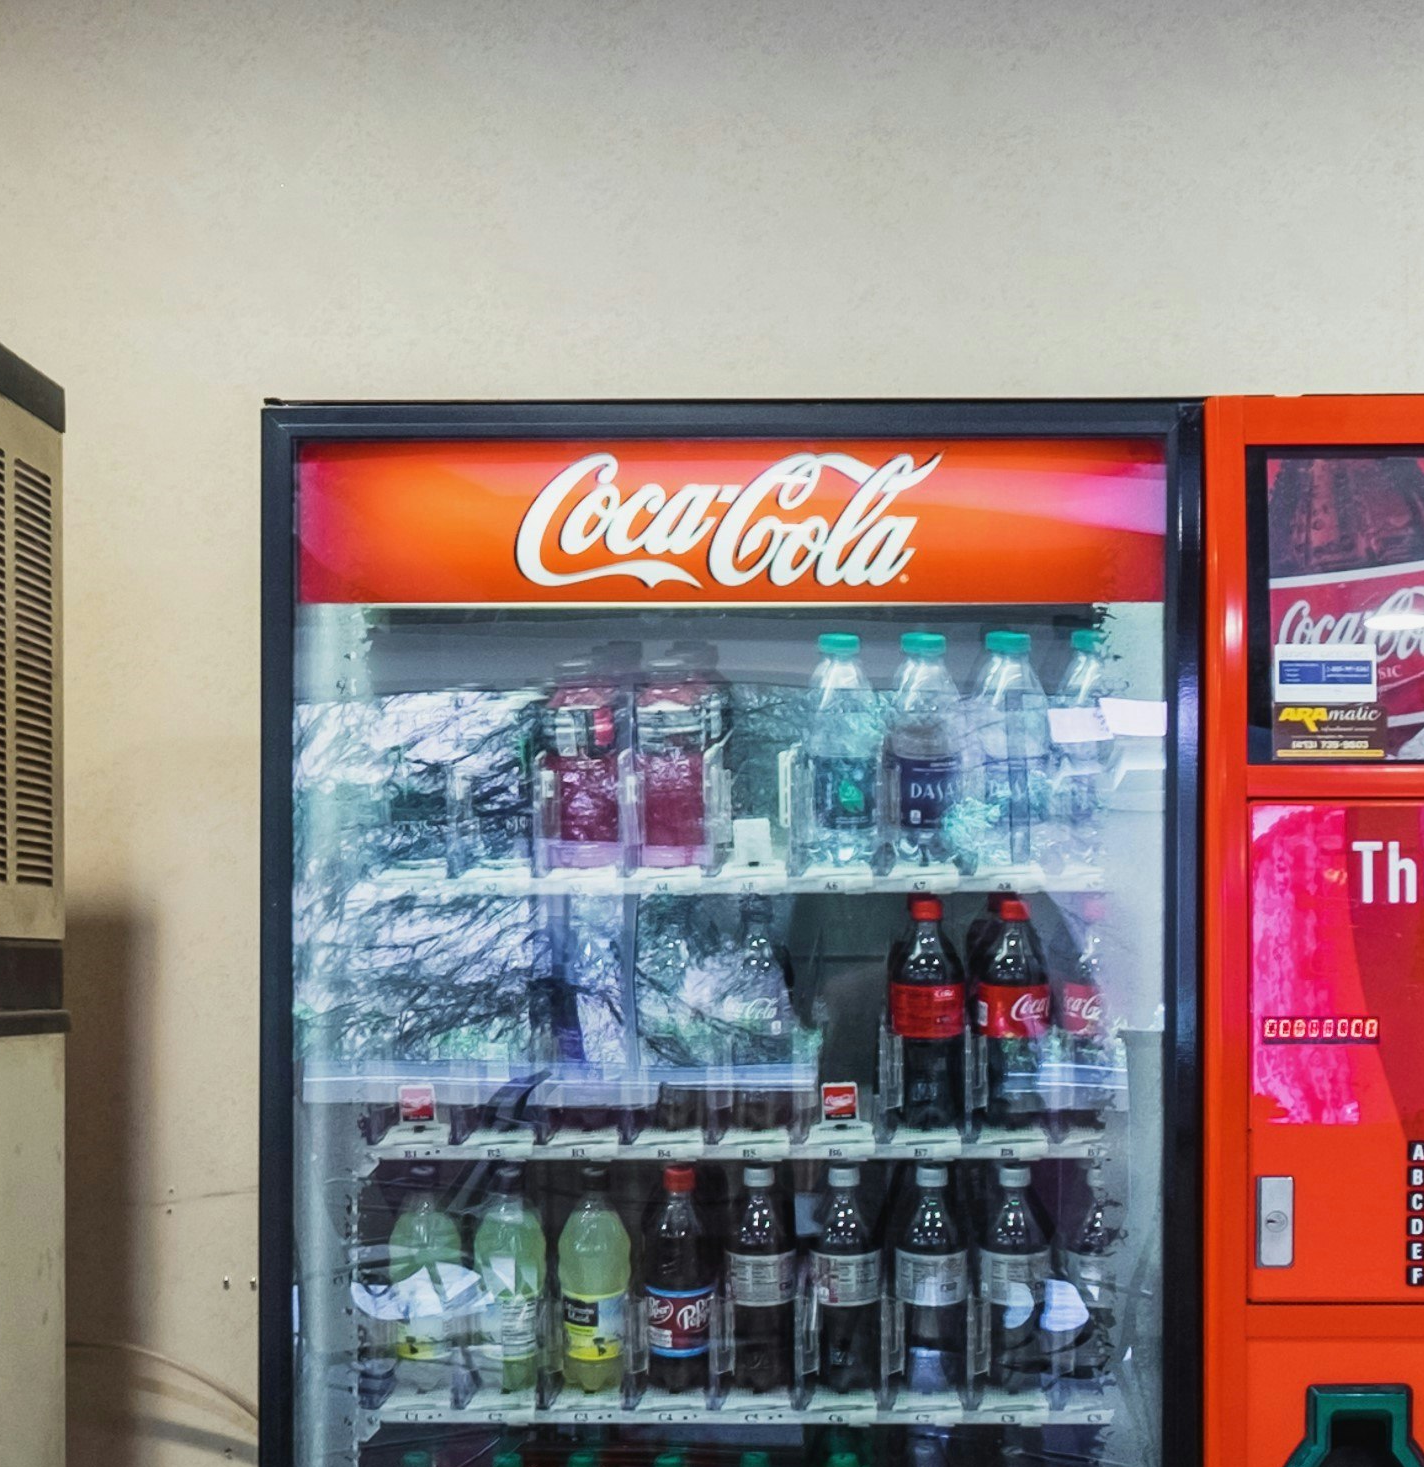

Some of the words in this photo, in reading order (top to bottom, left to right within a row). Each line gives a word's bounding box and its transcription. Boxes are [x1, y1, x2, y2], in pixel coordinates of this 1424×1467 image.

[514, 447, 946, 589] Coca-Cola
[1278, 706, 1381, 733] ARAmatic
[1412, 1144, 1424, 1161] A
[1412, 1169, 1423, 1186] B
[1411, 1193, 1423, 1211] C
[1411, 1219, 1423, 1235] D
[1411, 1243, 1422, 1260] E
[1412, 1268, 1422, 1285] F
